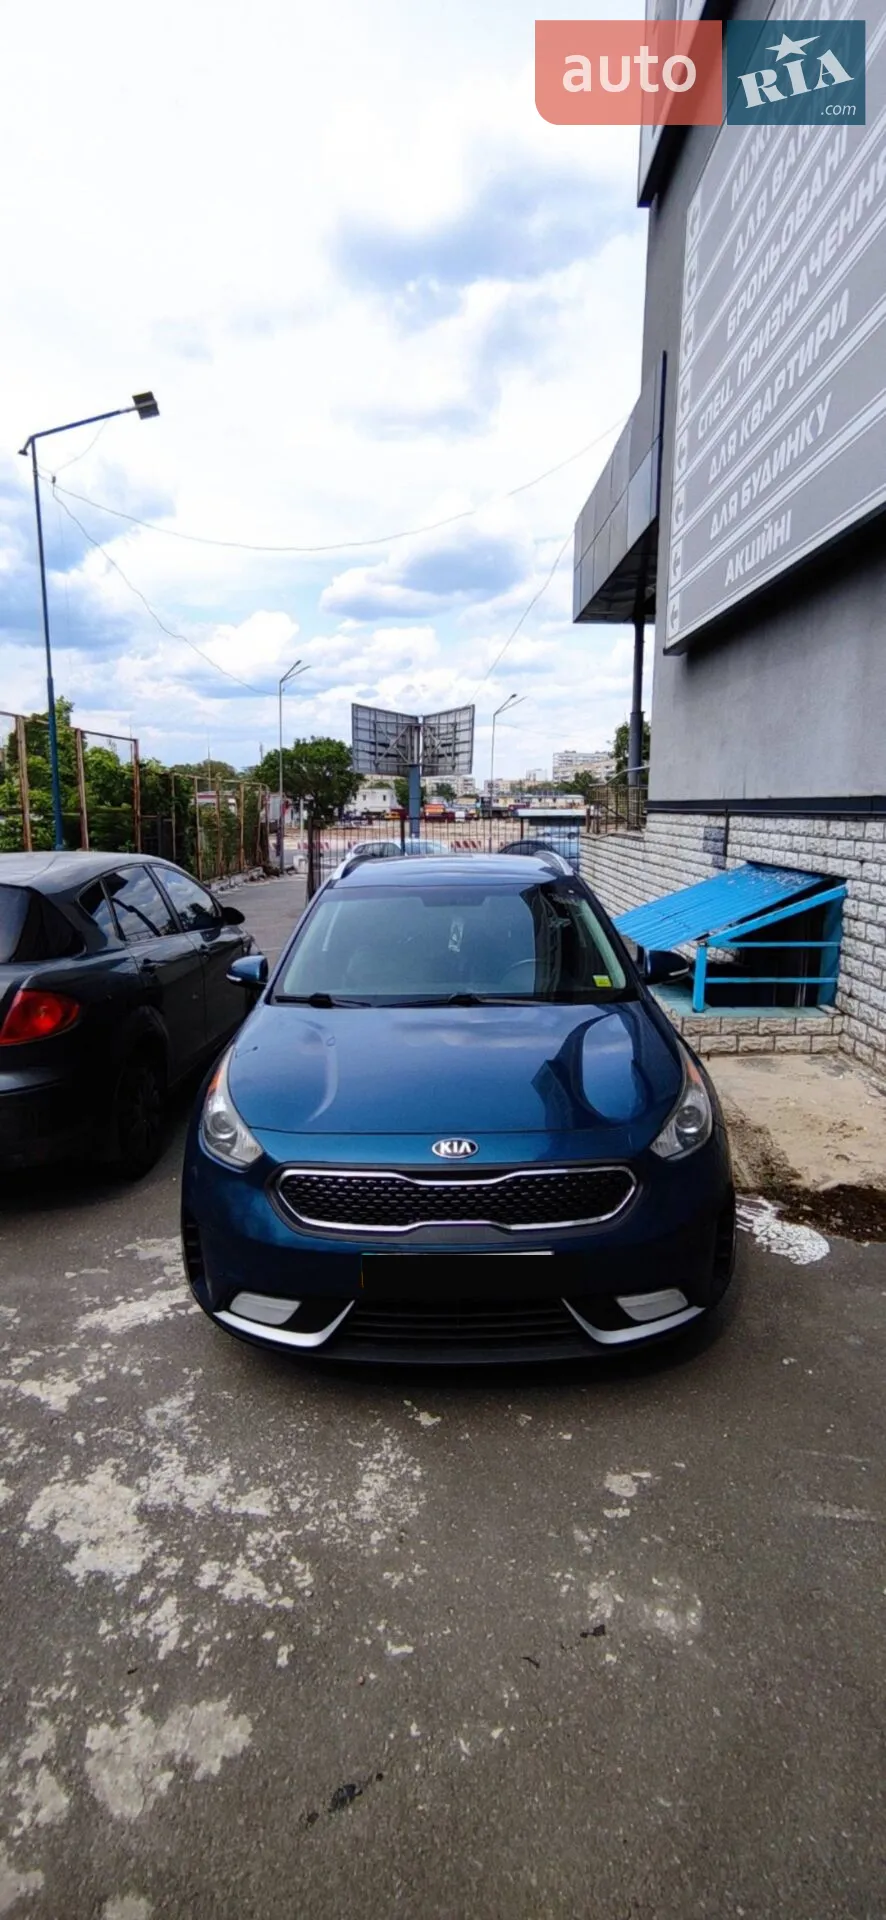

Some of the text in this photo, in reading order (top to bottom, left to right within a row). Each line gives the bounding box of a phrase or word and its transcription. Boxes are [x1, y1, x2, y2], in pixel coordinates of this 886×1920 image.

[727, 123, 848, 342] БРОНЬОВАНІ
[733, 187, 768, 270] ДЛЯ
[708, 288, 849, 485] ДЛЯ КВАРТИРИ
[710, 391, 832, 541] ДЛЯ БУДИНКУ
[440, 1141, 472, 1154] KIA
